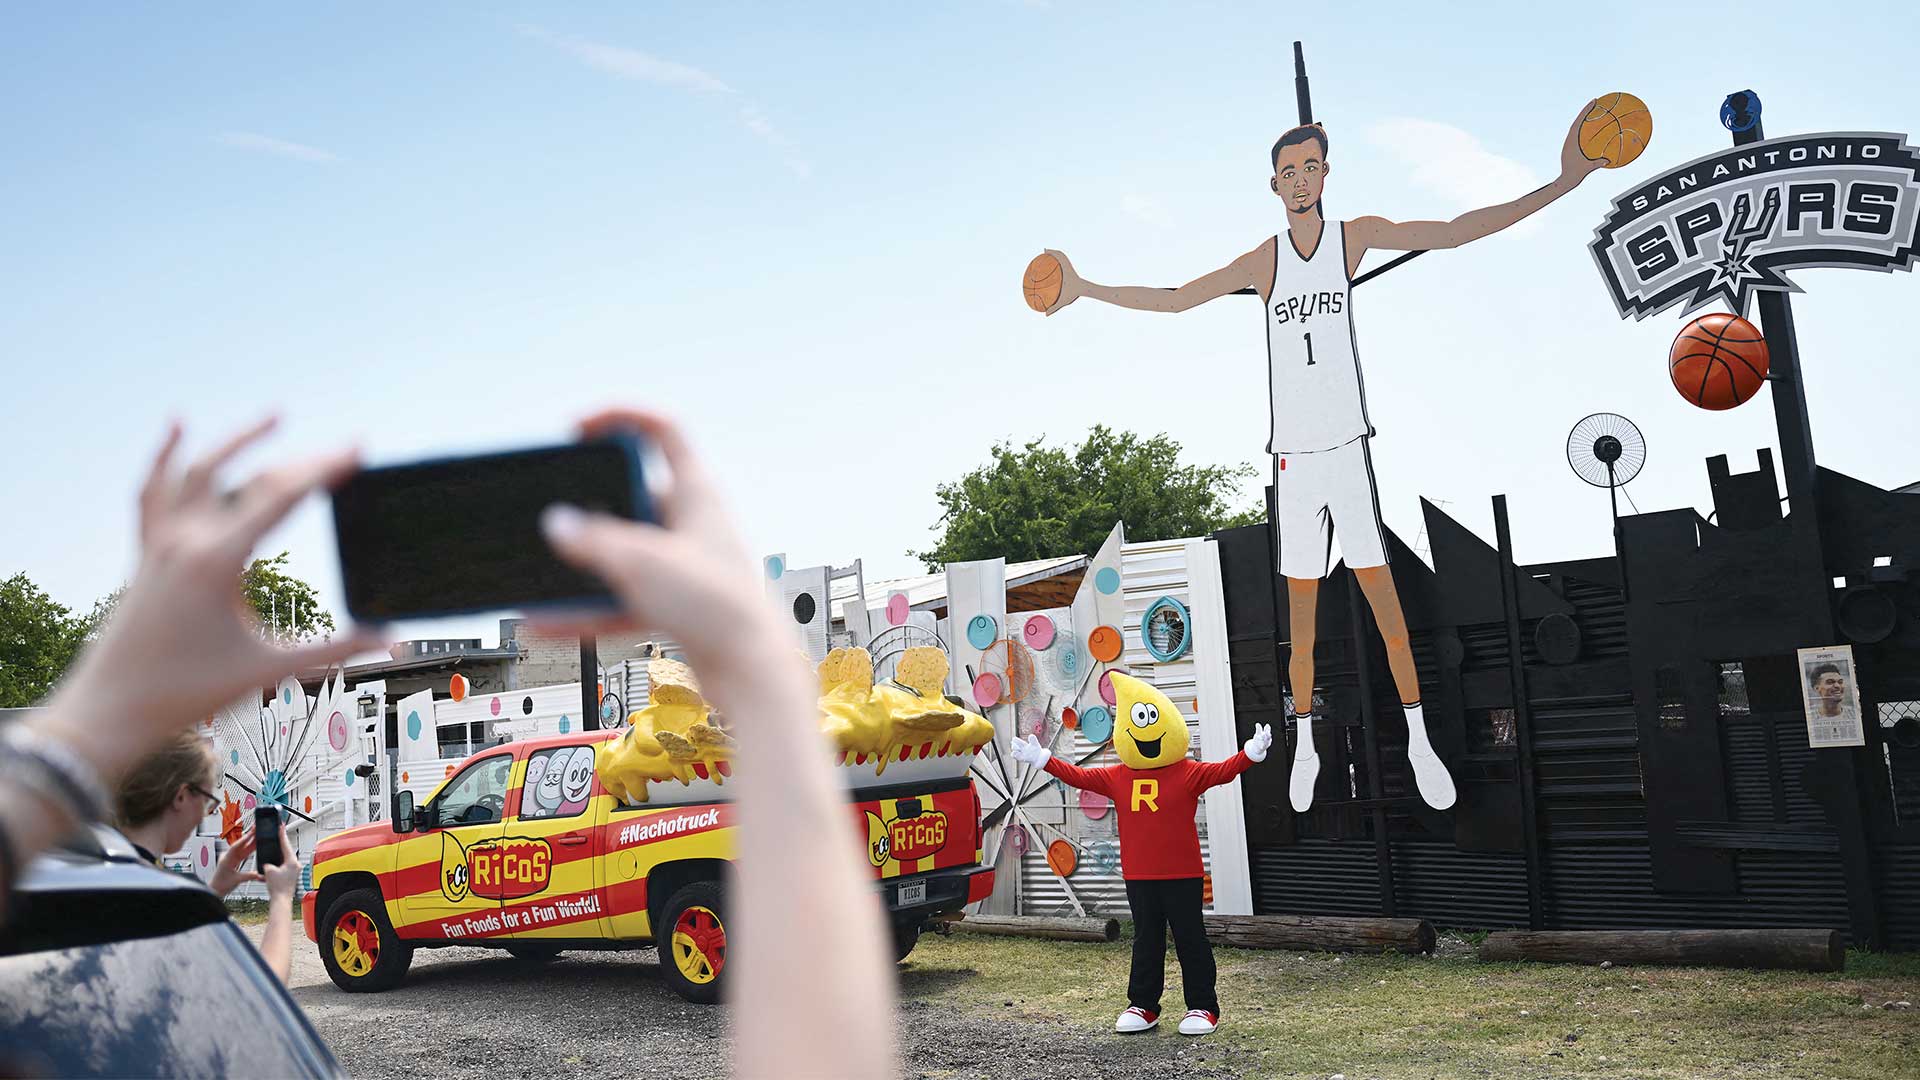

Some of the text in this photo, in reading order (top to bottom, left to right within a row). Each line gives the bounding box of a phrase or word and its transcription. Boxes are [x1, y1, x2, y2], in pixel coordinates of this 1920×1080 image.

[1632, 144, 1881, 212] SAN ANTONIO
[1625, 181, 1900, 283] SPURS
[1274, 292, 1344, 325] SPURS
[1303, 332, 1316, 366] 1
[1130, 778, 1160, 812] R
[620, 808, 720, 845] #Nachotruck
[904, 886, 920, 900] RICOS
[441, 895, 601, 938] Fun Foods for a Fun World!
